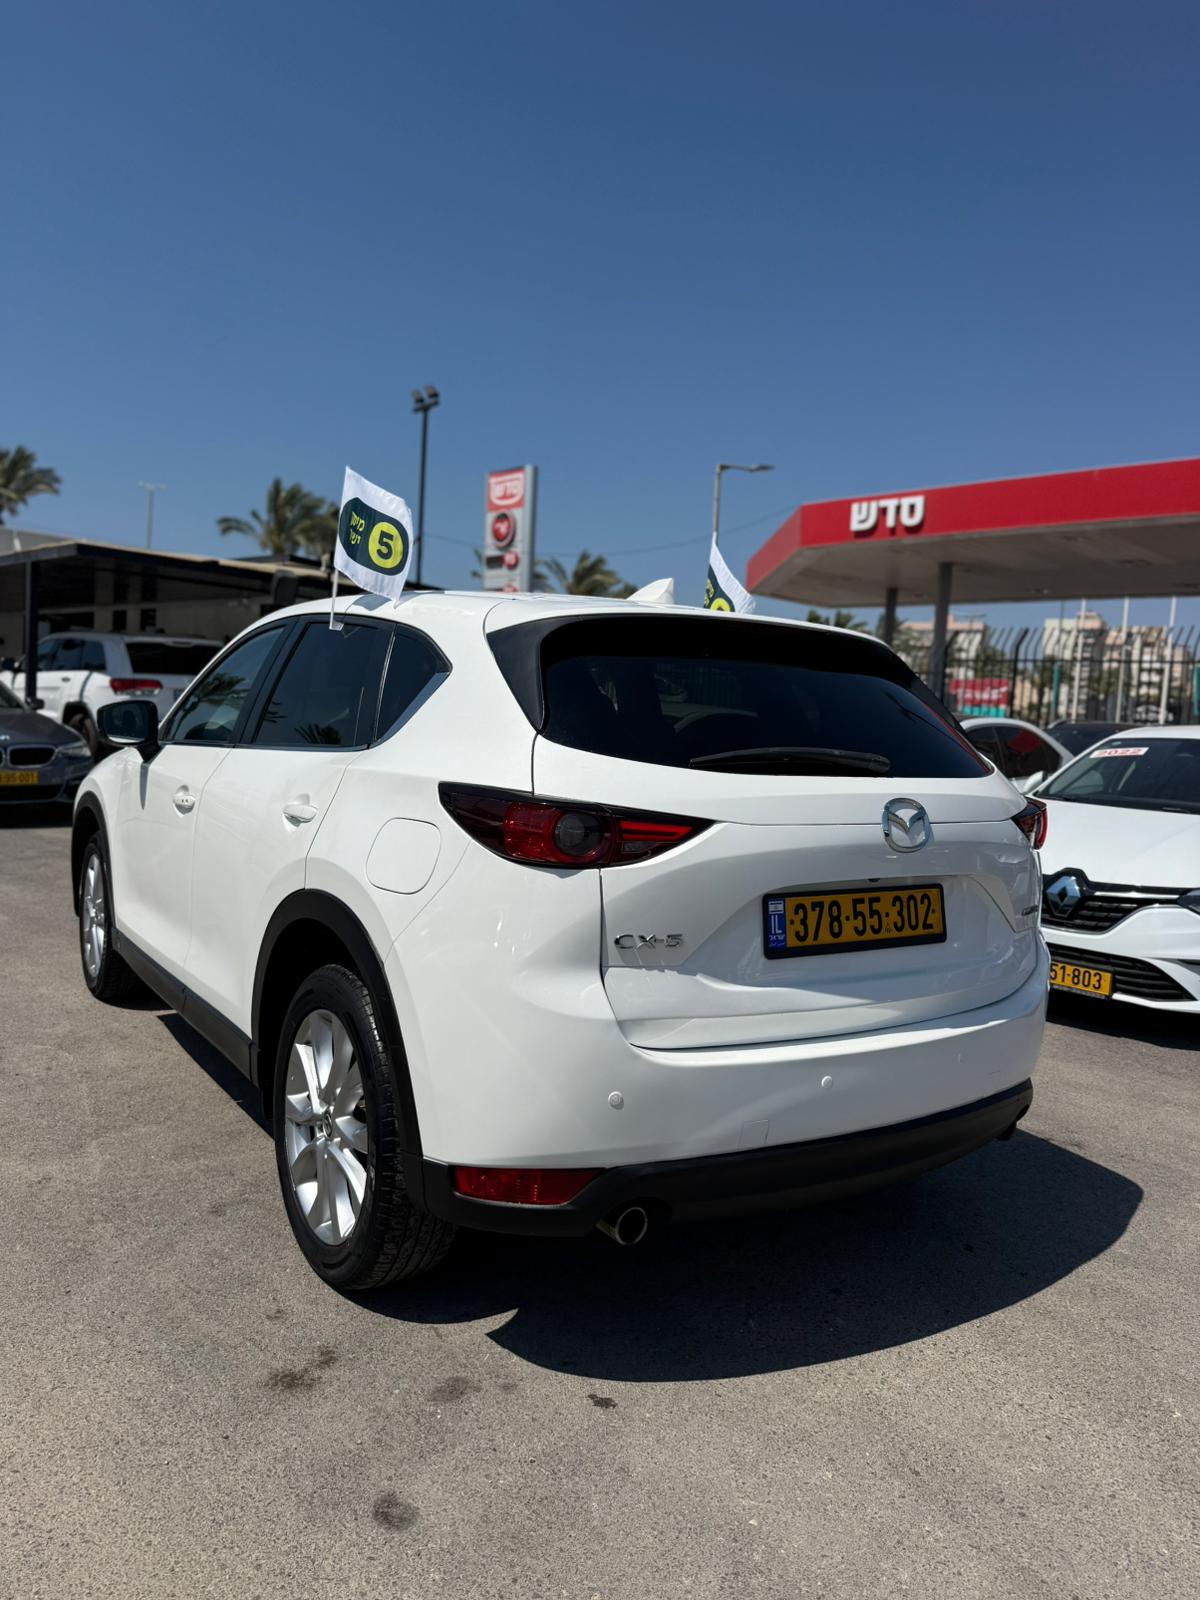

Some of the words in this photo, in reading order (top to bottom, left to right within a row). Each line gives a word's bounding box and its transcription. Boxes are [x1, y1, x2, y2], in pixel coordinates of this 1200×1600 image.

[849, 495, 926, 532] סדש
[376, 530, 394, 560] 5
[771, 914, 783, 935] IL
[614, 933, 683, 949] CX-5
